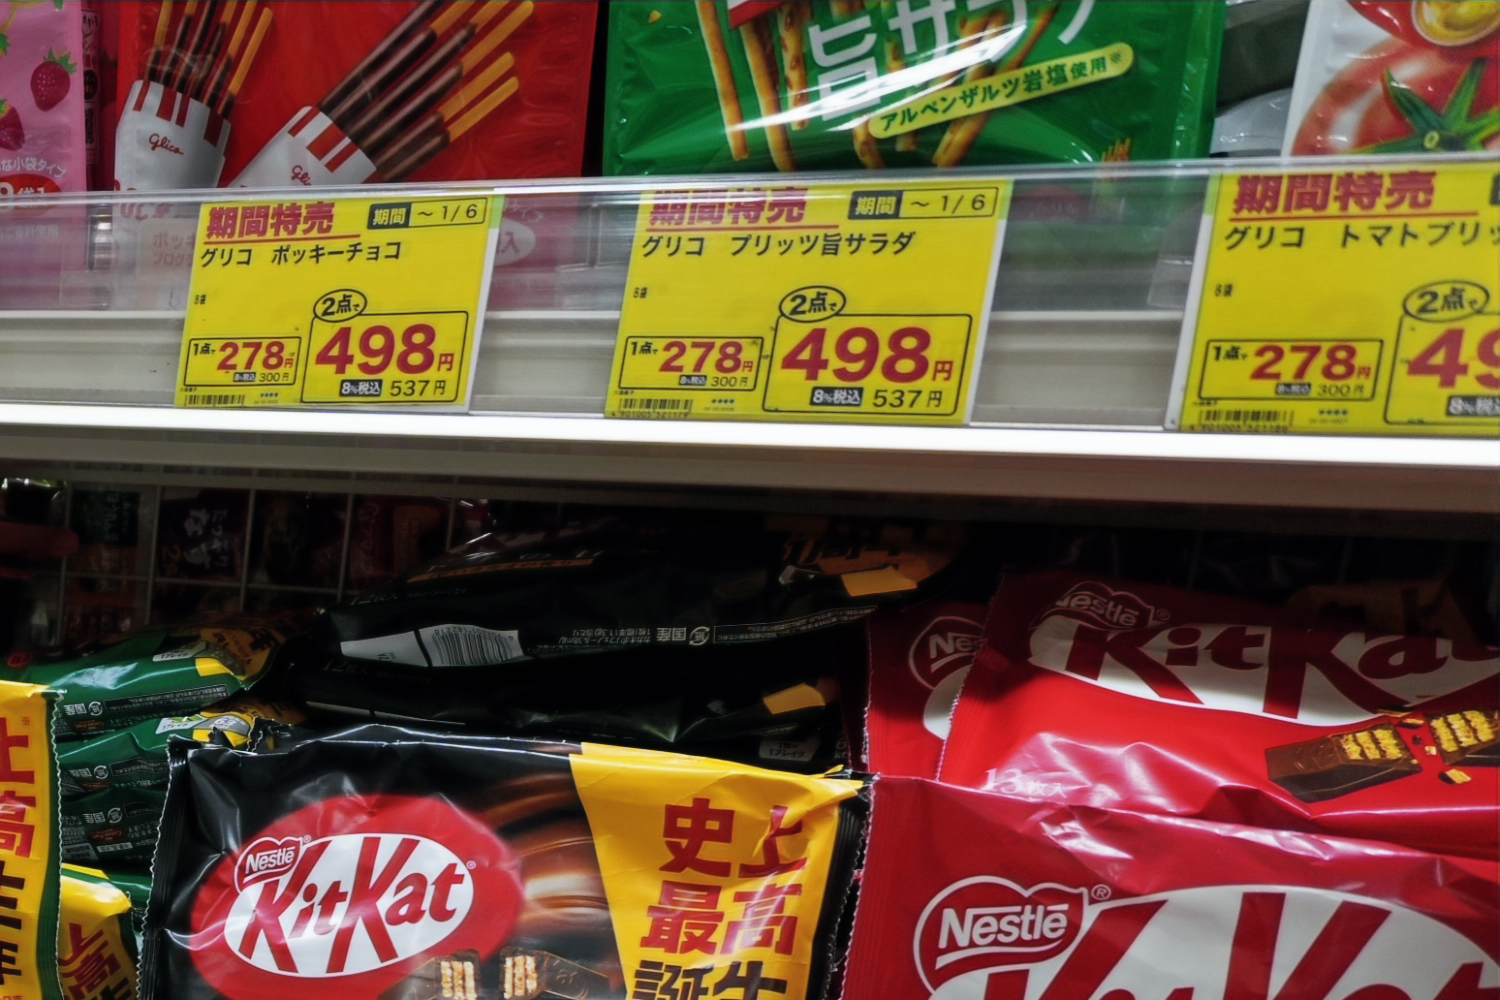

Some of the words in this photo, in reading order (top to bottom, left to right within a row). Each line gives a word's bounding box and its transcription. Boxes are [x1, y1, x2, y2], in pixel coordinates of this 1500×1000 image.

[650, 186, 808, 226] 期間特売
[855, 196, 896, 215] 期間
[1235, 171, 1437, 214] 期間特売
[206, 202, 335, 239] 期間特売
[373, 208, 406, 225] 期間
[1225, 226, 1306, 250] グリコ
[201, 247, 253, 268] グリコ
[271, 241, 402, 265] ポッキーチョコ
[642, 236, 706, 257] グリコ
[320, 295, 360, 317] 2点で
[789, 292, 837, 315] 2点で
[661, 796, 808, 880] 史上
[243, 846, 298, 877] Nestlé
[237, 836, 472, 976] KitKat
[638, 879, 804, 957] 最高
[938, 904, 1070, 953] Nestlé
